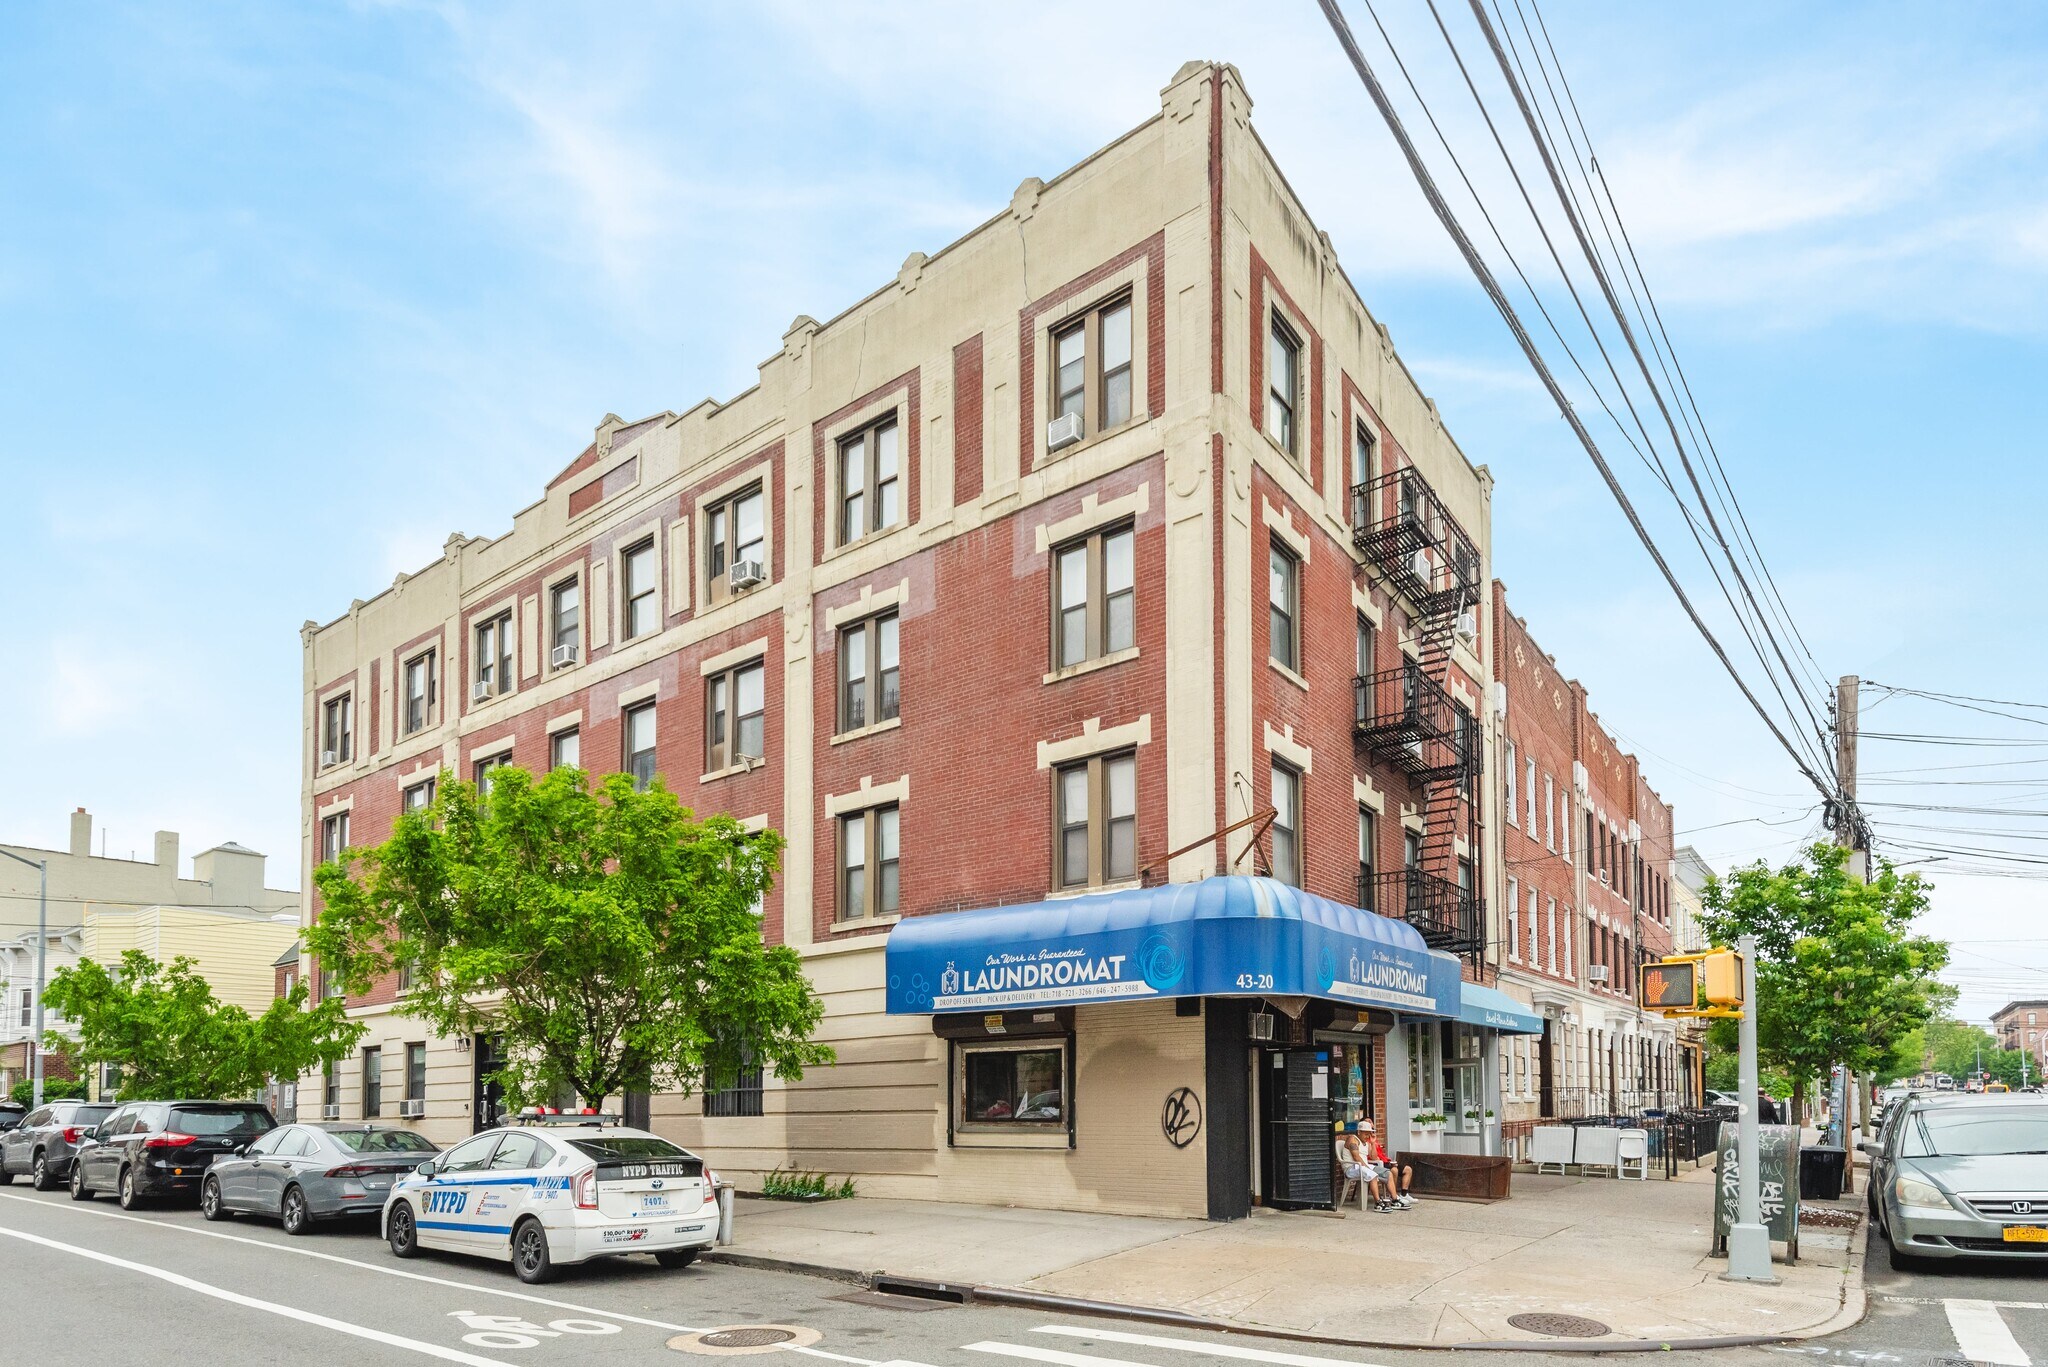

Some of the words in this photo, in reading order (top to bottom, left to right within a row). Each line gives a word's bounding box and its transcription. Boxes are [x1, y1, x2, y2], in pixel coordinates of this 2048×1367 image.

[985, 954, 1001, 966] Our
[1001, 953, 1026, 964] Work
[1027, 953, 1037, 961] is
[1038, 948, 1087, 961] Guaranteed
[963, 954, 1126, 992] LAUNDROMAT
[1361, 960, 1428, 995] LAUNDROMAT
[1236, 974, 1274, 989] 43-20
[962, 996, 982, 1005] SERVICE
[987, 995, 998, 1003] PICK
[1000, 994, 1008, 1002] UP
[1012, 992, 1036, 1001] DELIVERY
[622, 1164, 647, 1177] NYPD
[650, 1163, 684, 1176] TRAFFIC
[534, 1176, 567, 1189] TRAFFIC
[429, 1190, 468, 1214] NYPD
[644, 1197, 662, 1206] 7407
